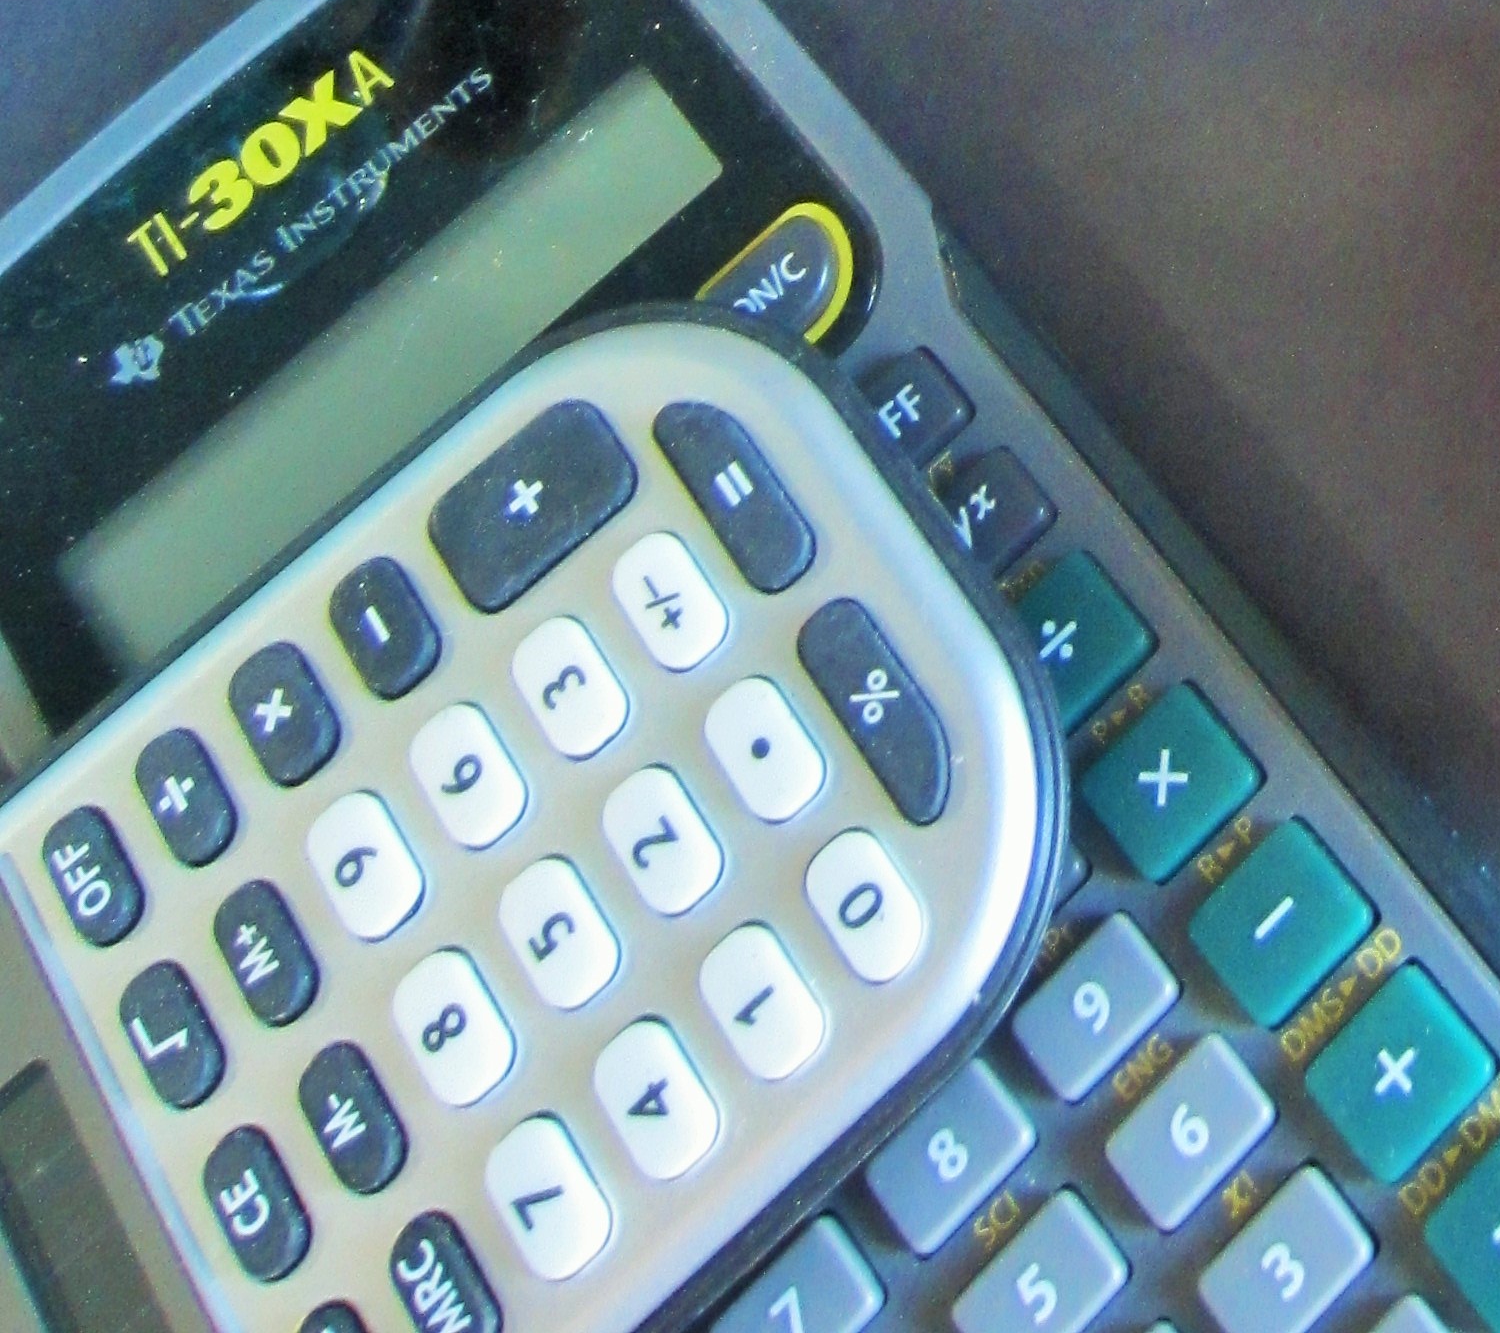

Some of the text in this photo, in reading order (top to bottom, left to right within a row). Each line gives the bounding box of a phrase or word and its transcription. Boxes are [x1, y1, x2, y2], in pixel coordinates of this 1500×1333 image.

[126, 50, 395, 277] TI-30XA
[167, 67, 493, 336] TEXAS INSTRUMENTS
[542, 664, 587, 710] 3
[850, 668, 899, 725] %
[439, 754, 482, 797] 6
[334, 844, 377, 889] 9
[631, 813, 679, 872] 2
[52, 841, 112, 918] OFF
[838, 881, 883, 930] 0
[236, 922, 281, 985] M+
[527, 911, 577, 962] 5
[421, 1001, 467, 1054] 8
[733, 984, 775, 1027] 1
[1073, 981, 1111, 1035] 9
[1111, 1032, 1175, 1102] ENG
[627, 1077, 668, 1117] 4
[927, 1127, 969, 1183] 8
[1170, 1102, 1210, 1157] 6
[219, 1167, 271, 1238] CE
[511, 1184, 564, 1232] 7
[398, 1238, 473, 1333] MRC
[1016, 1261, 1059, 1327] 5
[1260, 1241, 1305, 1303] 3
